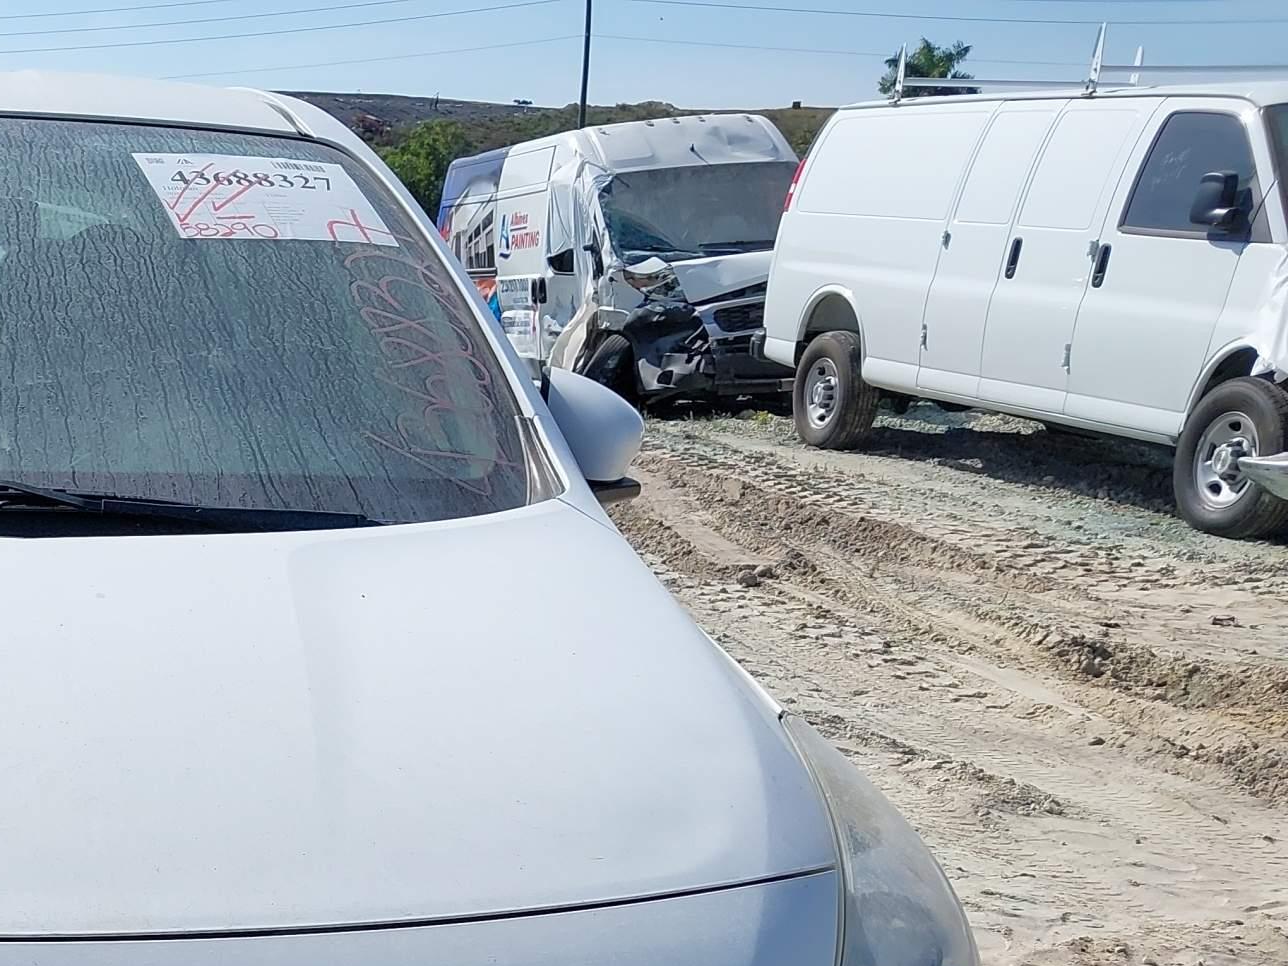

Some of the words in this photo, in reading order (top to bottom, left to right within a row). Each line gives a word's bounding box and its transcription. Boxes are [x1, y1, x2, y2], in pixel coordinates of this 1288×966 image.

[170, 170, 332, 192] 43688327
[179, 222, 279, 239] 58290
[511, 230, 540, 250] PAINTING
